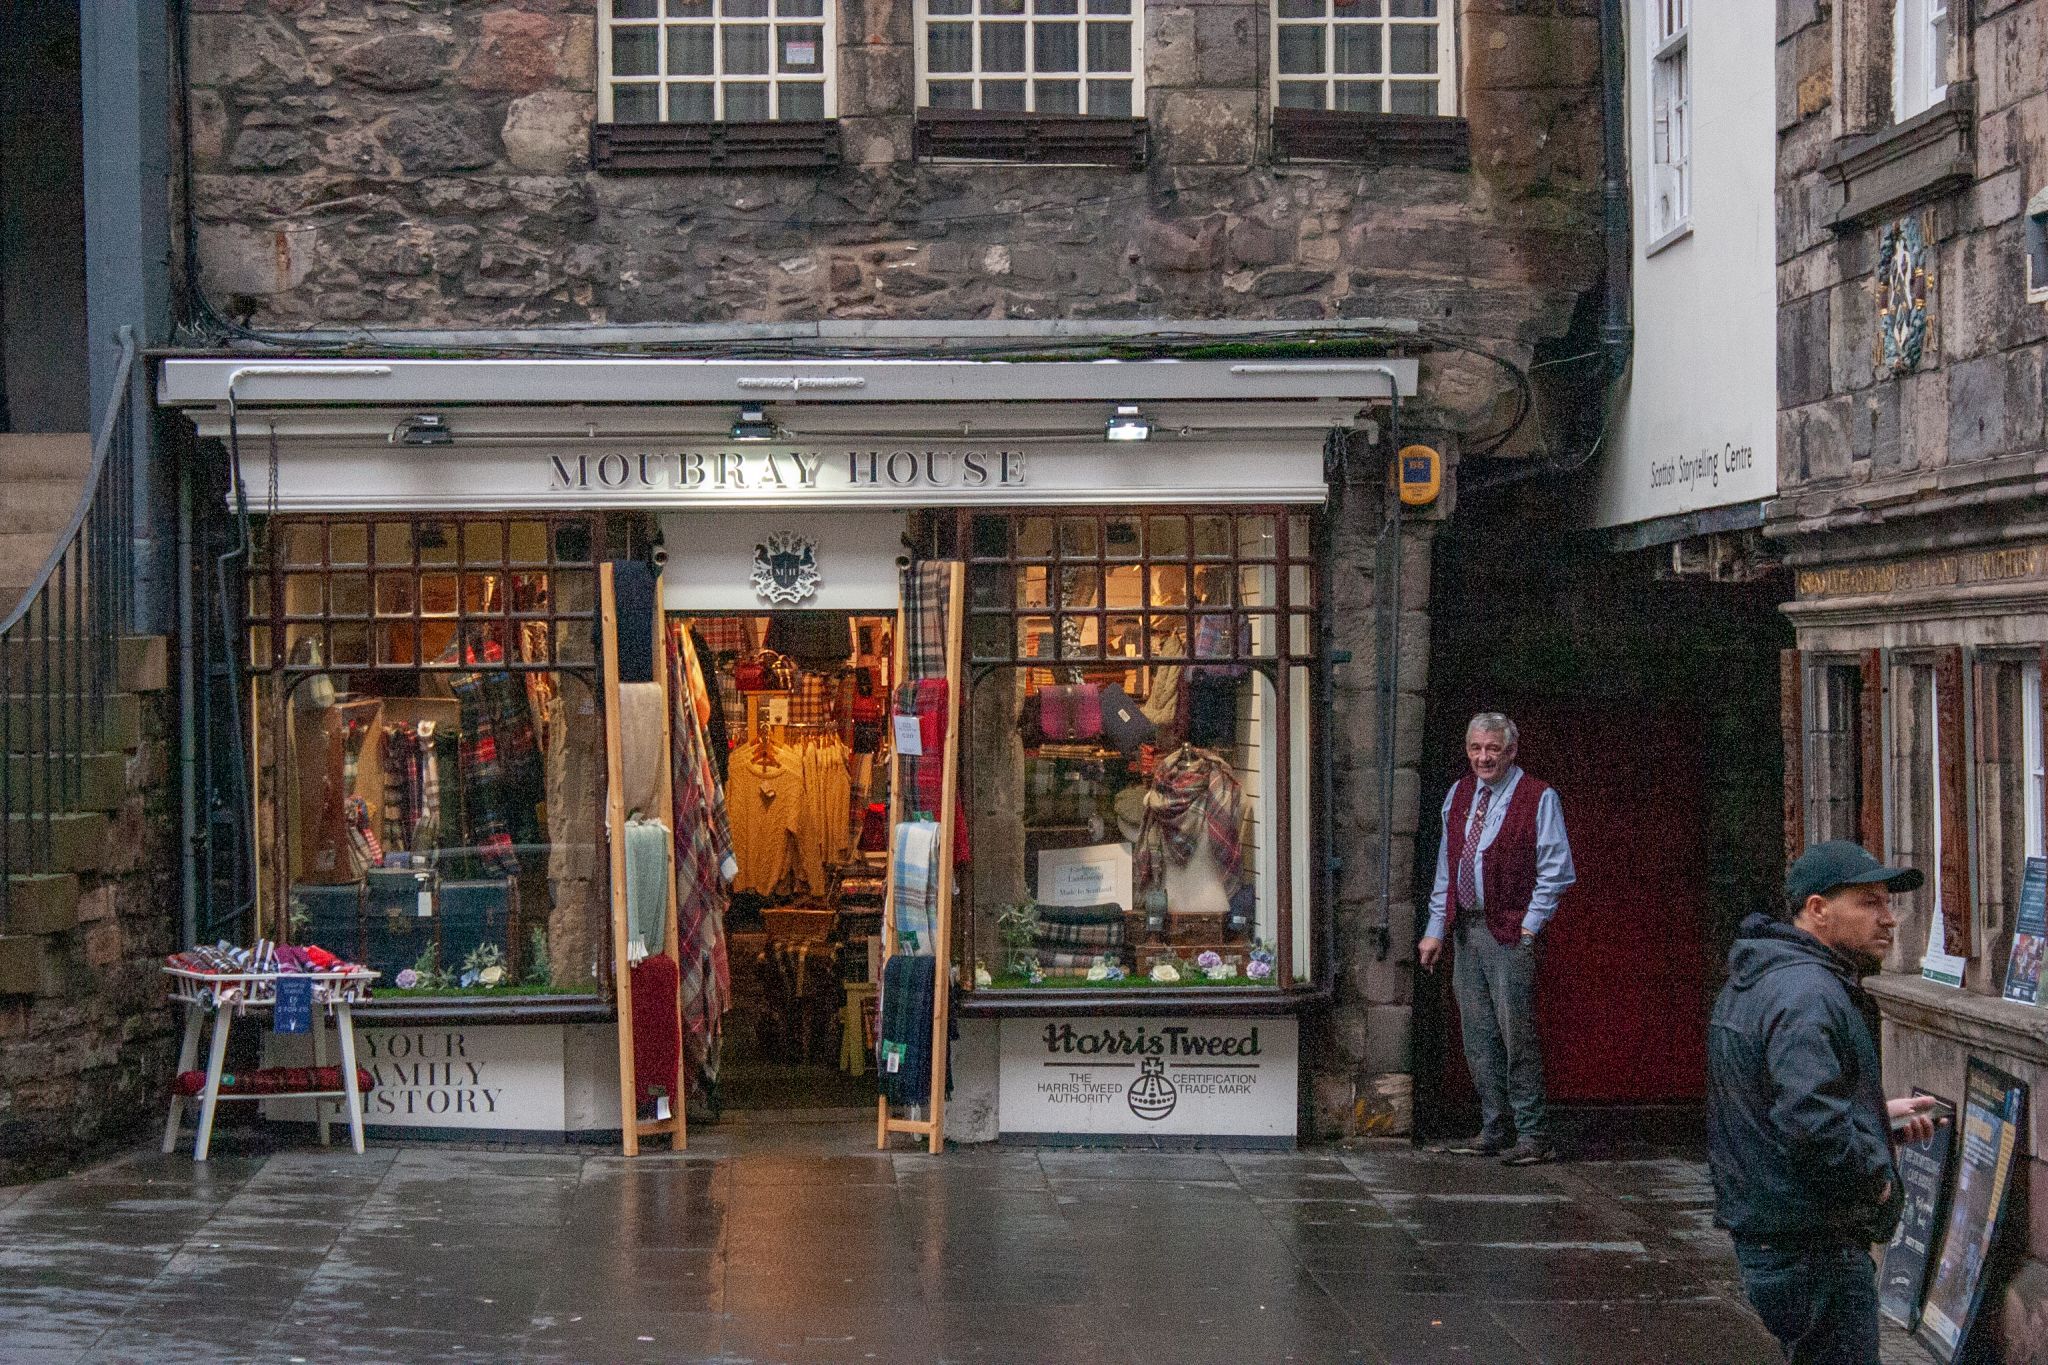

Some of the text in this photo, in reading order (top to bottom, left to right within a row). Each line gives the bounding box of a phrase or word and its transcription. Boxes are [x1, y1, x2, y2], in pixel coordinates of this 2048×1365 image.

[549, 451, 1026, 489] MOUBRAY HOUSE
[1651, 442, 1752, 492] Scottish Storytelling Centre
[364, 1033, 466, 1058] YOUR
[371, 1061, 485, 1087] AMILY
[1069, 1073, 1092, 1083] THE
[1172, 1074, 1257, 1085] CERTIFICATION
[1037, 1083, 1123, 1094] HARRIS TWEED
[1177, 1084, 1252, 1095] TRADE MARK
[1048, 1094, 1113, 1104] AUTHORITY
